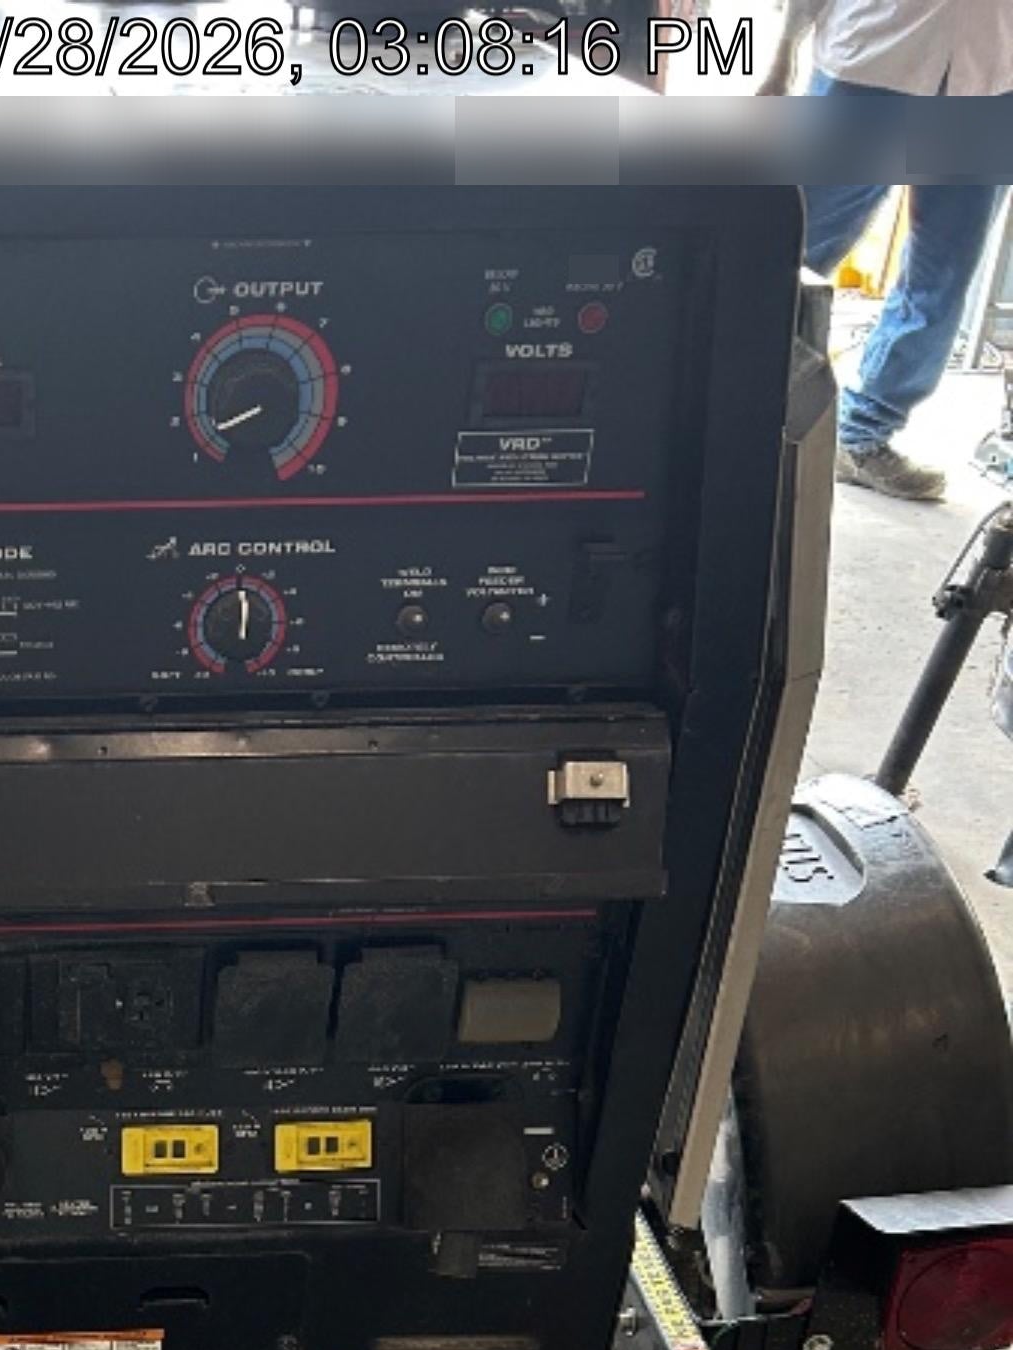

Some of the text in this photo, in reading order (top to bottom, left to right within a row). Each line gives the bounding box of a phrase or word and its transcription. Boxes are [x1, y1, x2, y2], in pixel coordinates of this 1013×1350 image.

[234, 280, 324, 298] OUTPUT
[505, 343, 573, 358] VOLTS
[188, 540, 336, 556] ARC CONTROL
